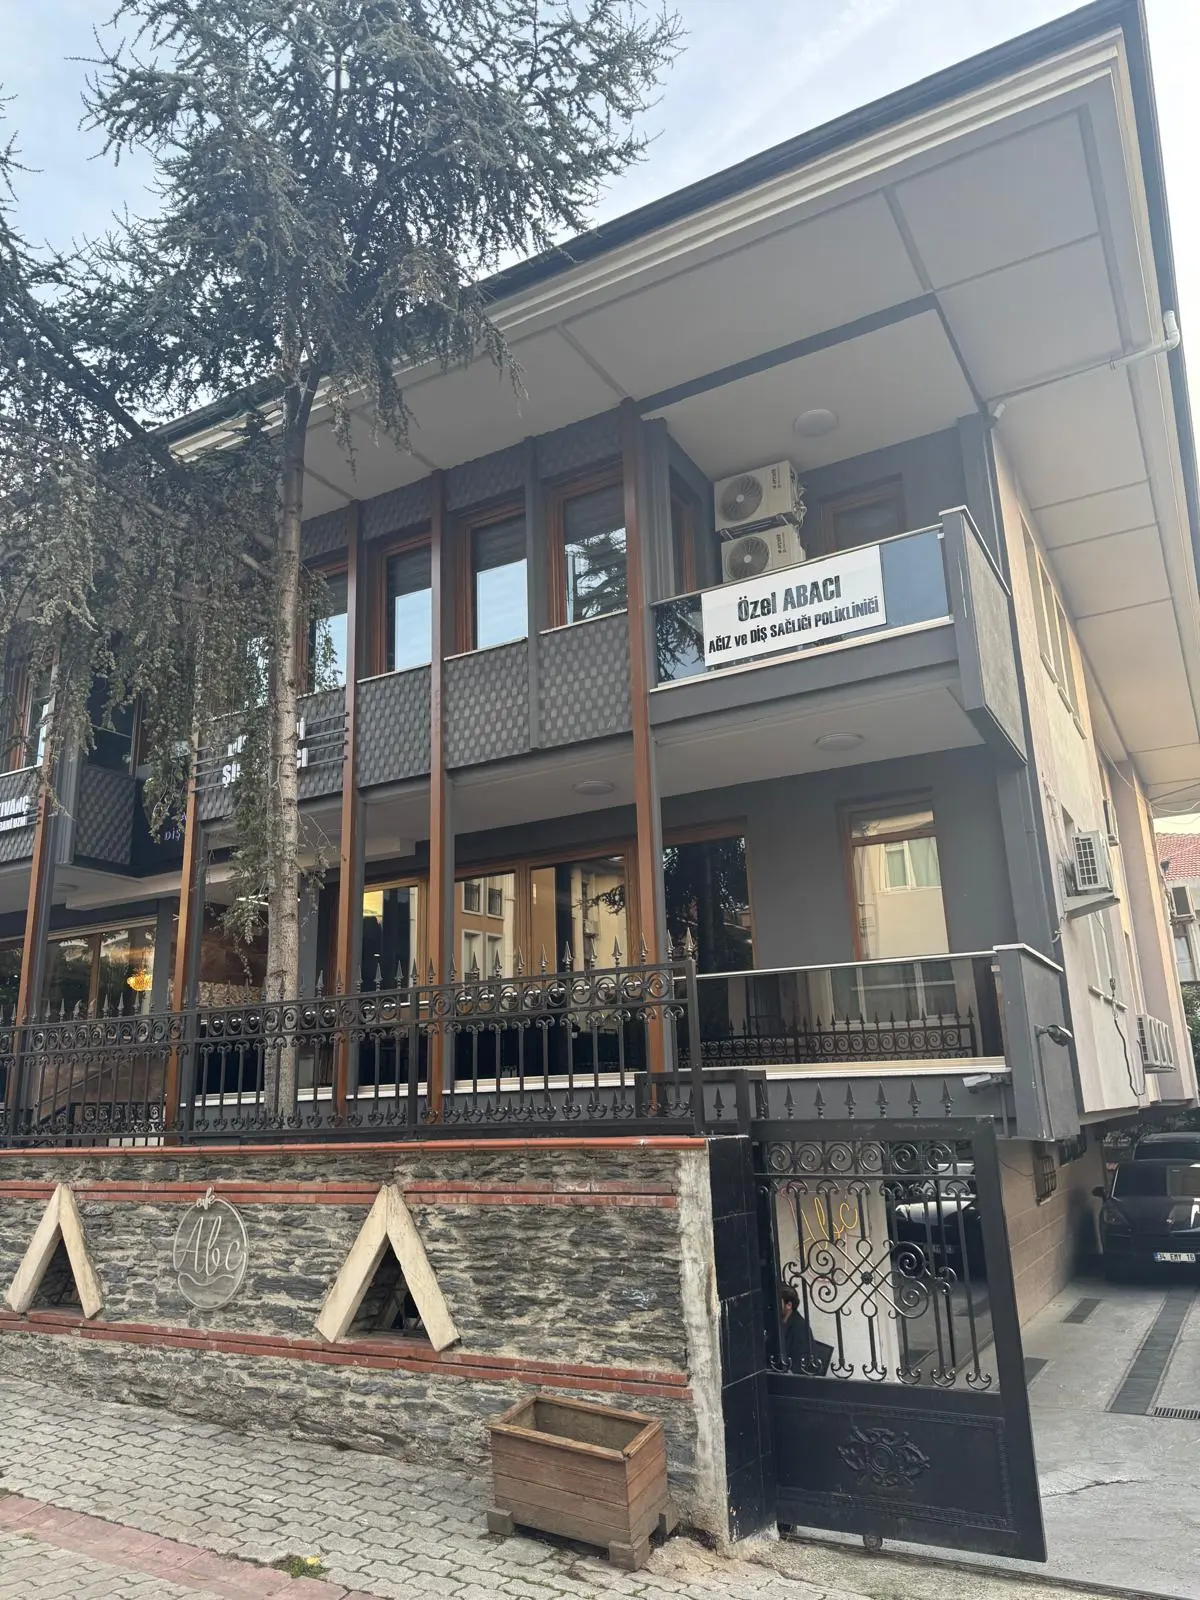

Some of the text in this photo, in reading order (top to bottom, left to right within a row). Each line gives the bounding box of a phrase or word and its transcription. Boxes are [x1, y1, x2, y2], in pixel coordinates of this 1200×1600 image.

[708, 595, 879, 654] AĞIZ ve DİŞ SAĞLIĞI POLİKLİNİĞİ
[738, 575, 841, 622] Özel ABACI
[176, 1216, 242, 1276] Abc
